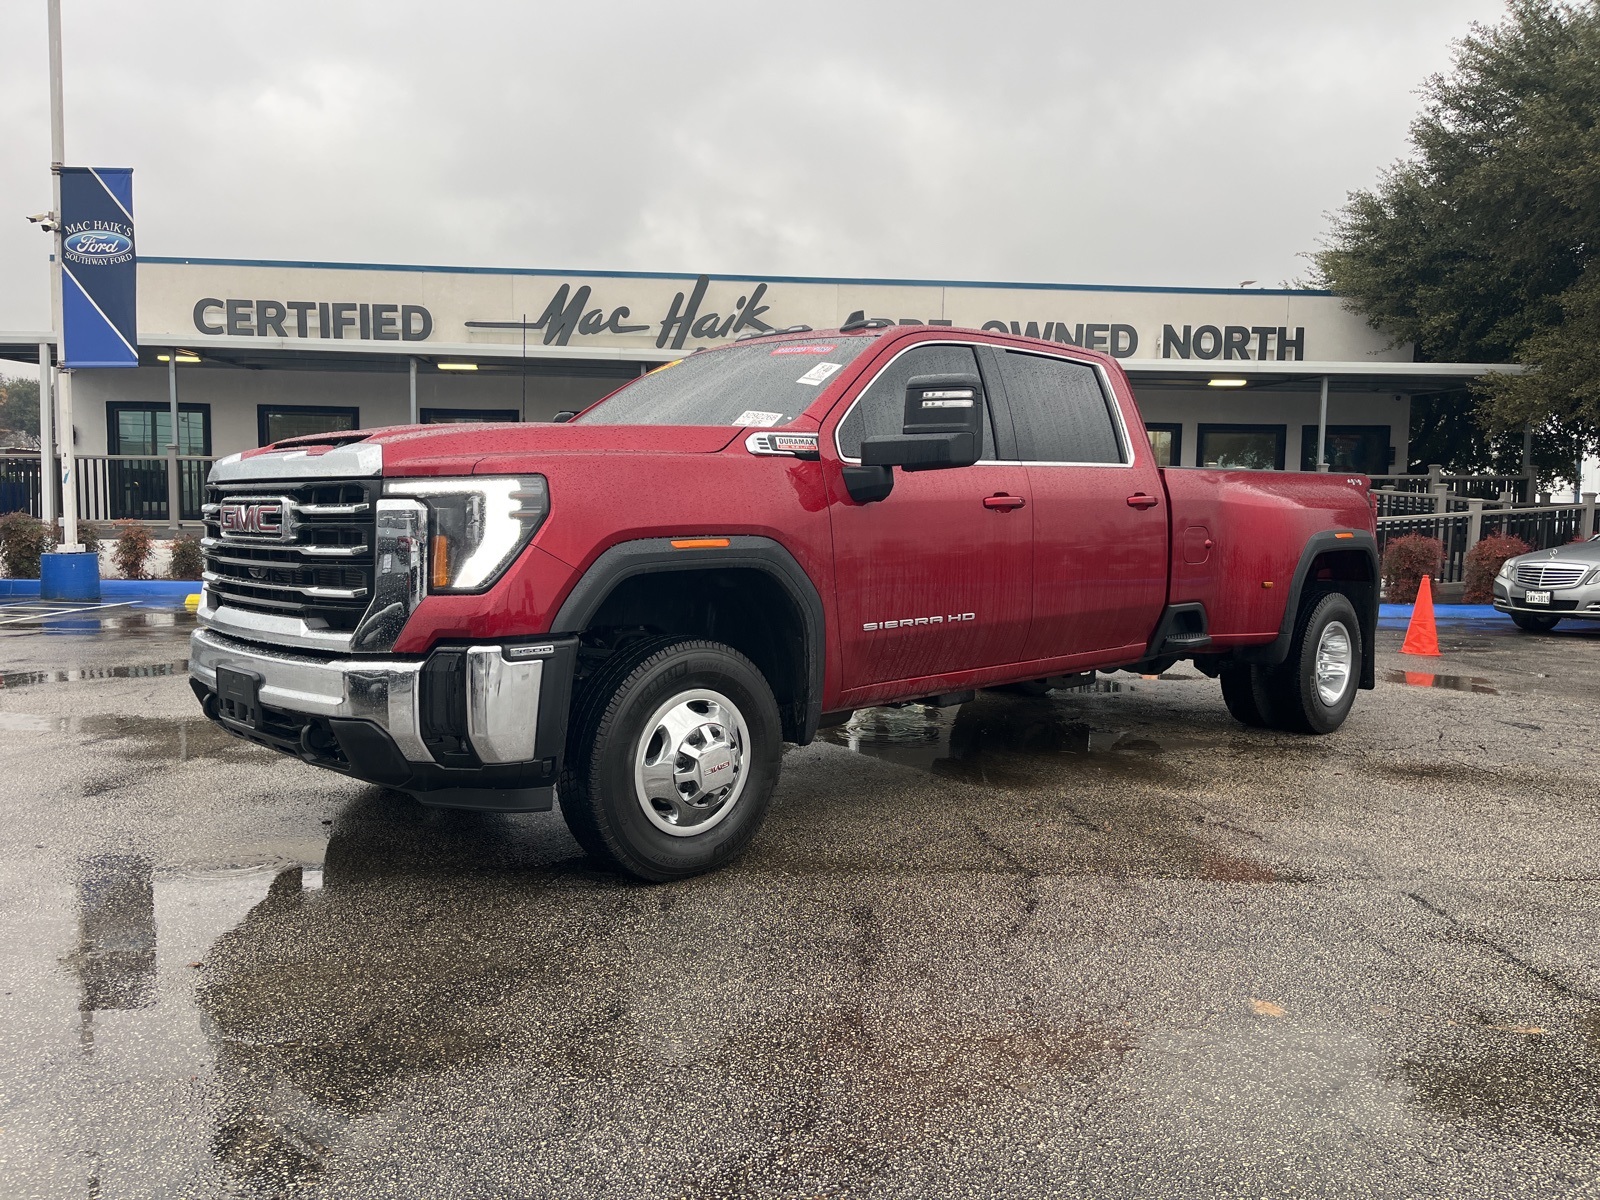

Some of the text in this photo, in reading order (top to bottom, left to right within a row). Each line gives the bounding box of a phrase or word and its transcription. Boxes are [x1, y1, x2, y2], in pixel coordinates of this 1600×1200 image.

[65, 220, 133, 237] MAC HAIK'S
[76, 234, 119, 253] Ford
[64, 251, 133, 266] SOUTHWAY FORD
[193, 297, 433, 341] CERTIFIED
[464, 274, 774, 350] Mac Haik
[1163, 324, 1304, 361] NORTH
[778, 437, 815, 446] DURAMAX
[220, 504, 282, 534] GMC
[862, 612, 976, 632] SIERRA HD
